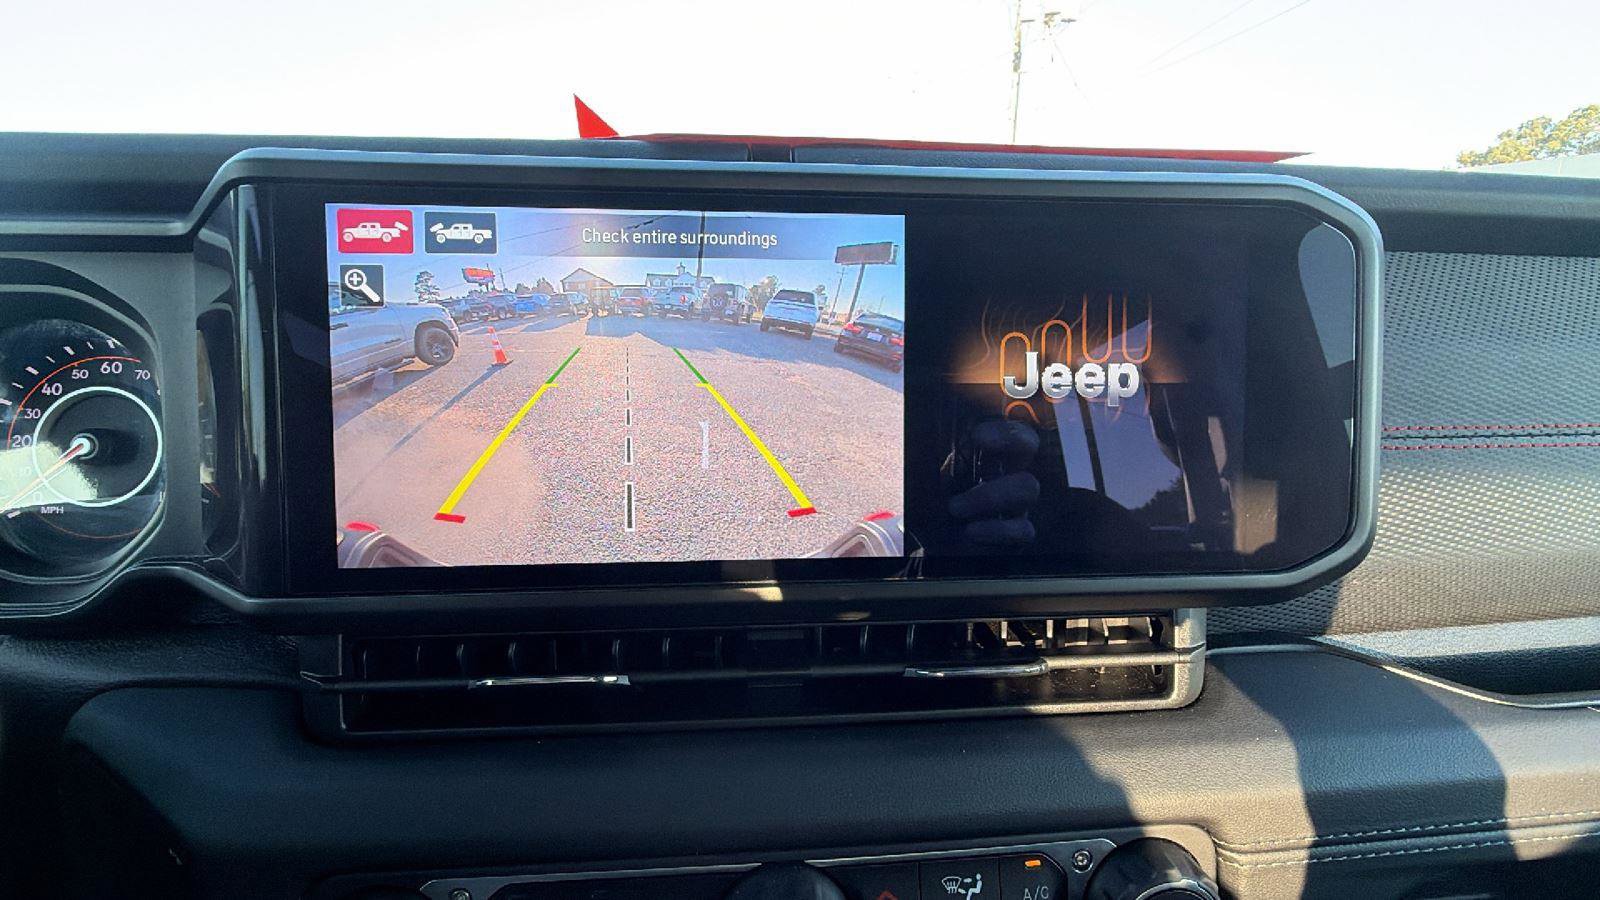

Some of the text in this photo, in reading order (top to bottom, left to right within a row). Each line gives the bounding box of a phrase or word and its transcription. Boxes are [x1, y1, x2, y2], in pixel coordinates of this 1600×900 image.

[582, 227, 778, 249] Check entire surroundings
[100, 361, 123, 374] 60
[71, 369, 89, 380] 50
[134, 369, 151, 381] 70
[1002, 351, 1140, 407] Jeep
[41, 383, 63, 396] 40
[24, 409, 41, 420] 30
[12, 435, 33, 448] 20
[40, 506, 64, 514] MPH
[1023, 885, 1049, 900] A/C
